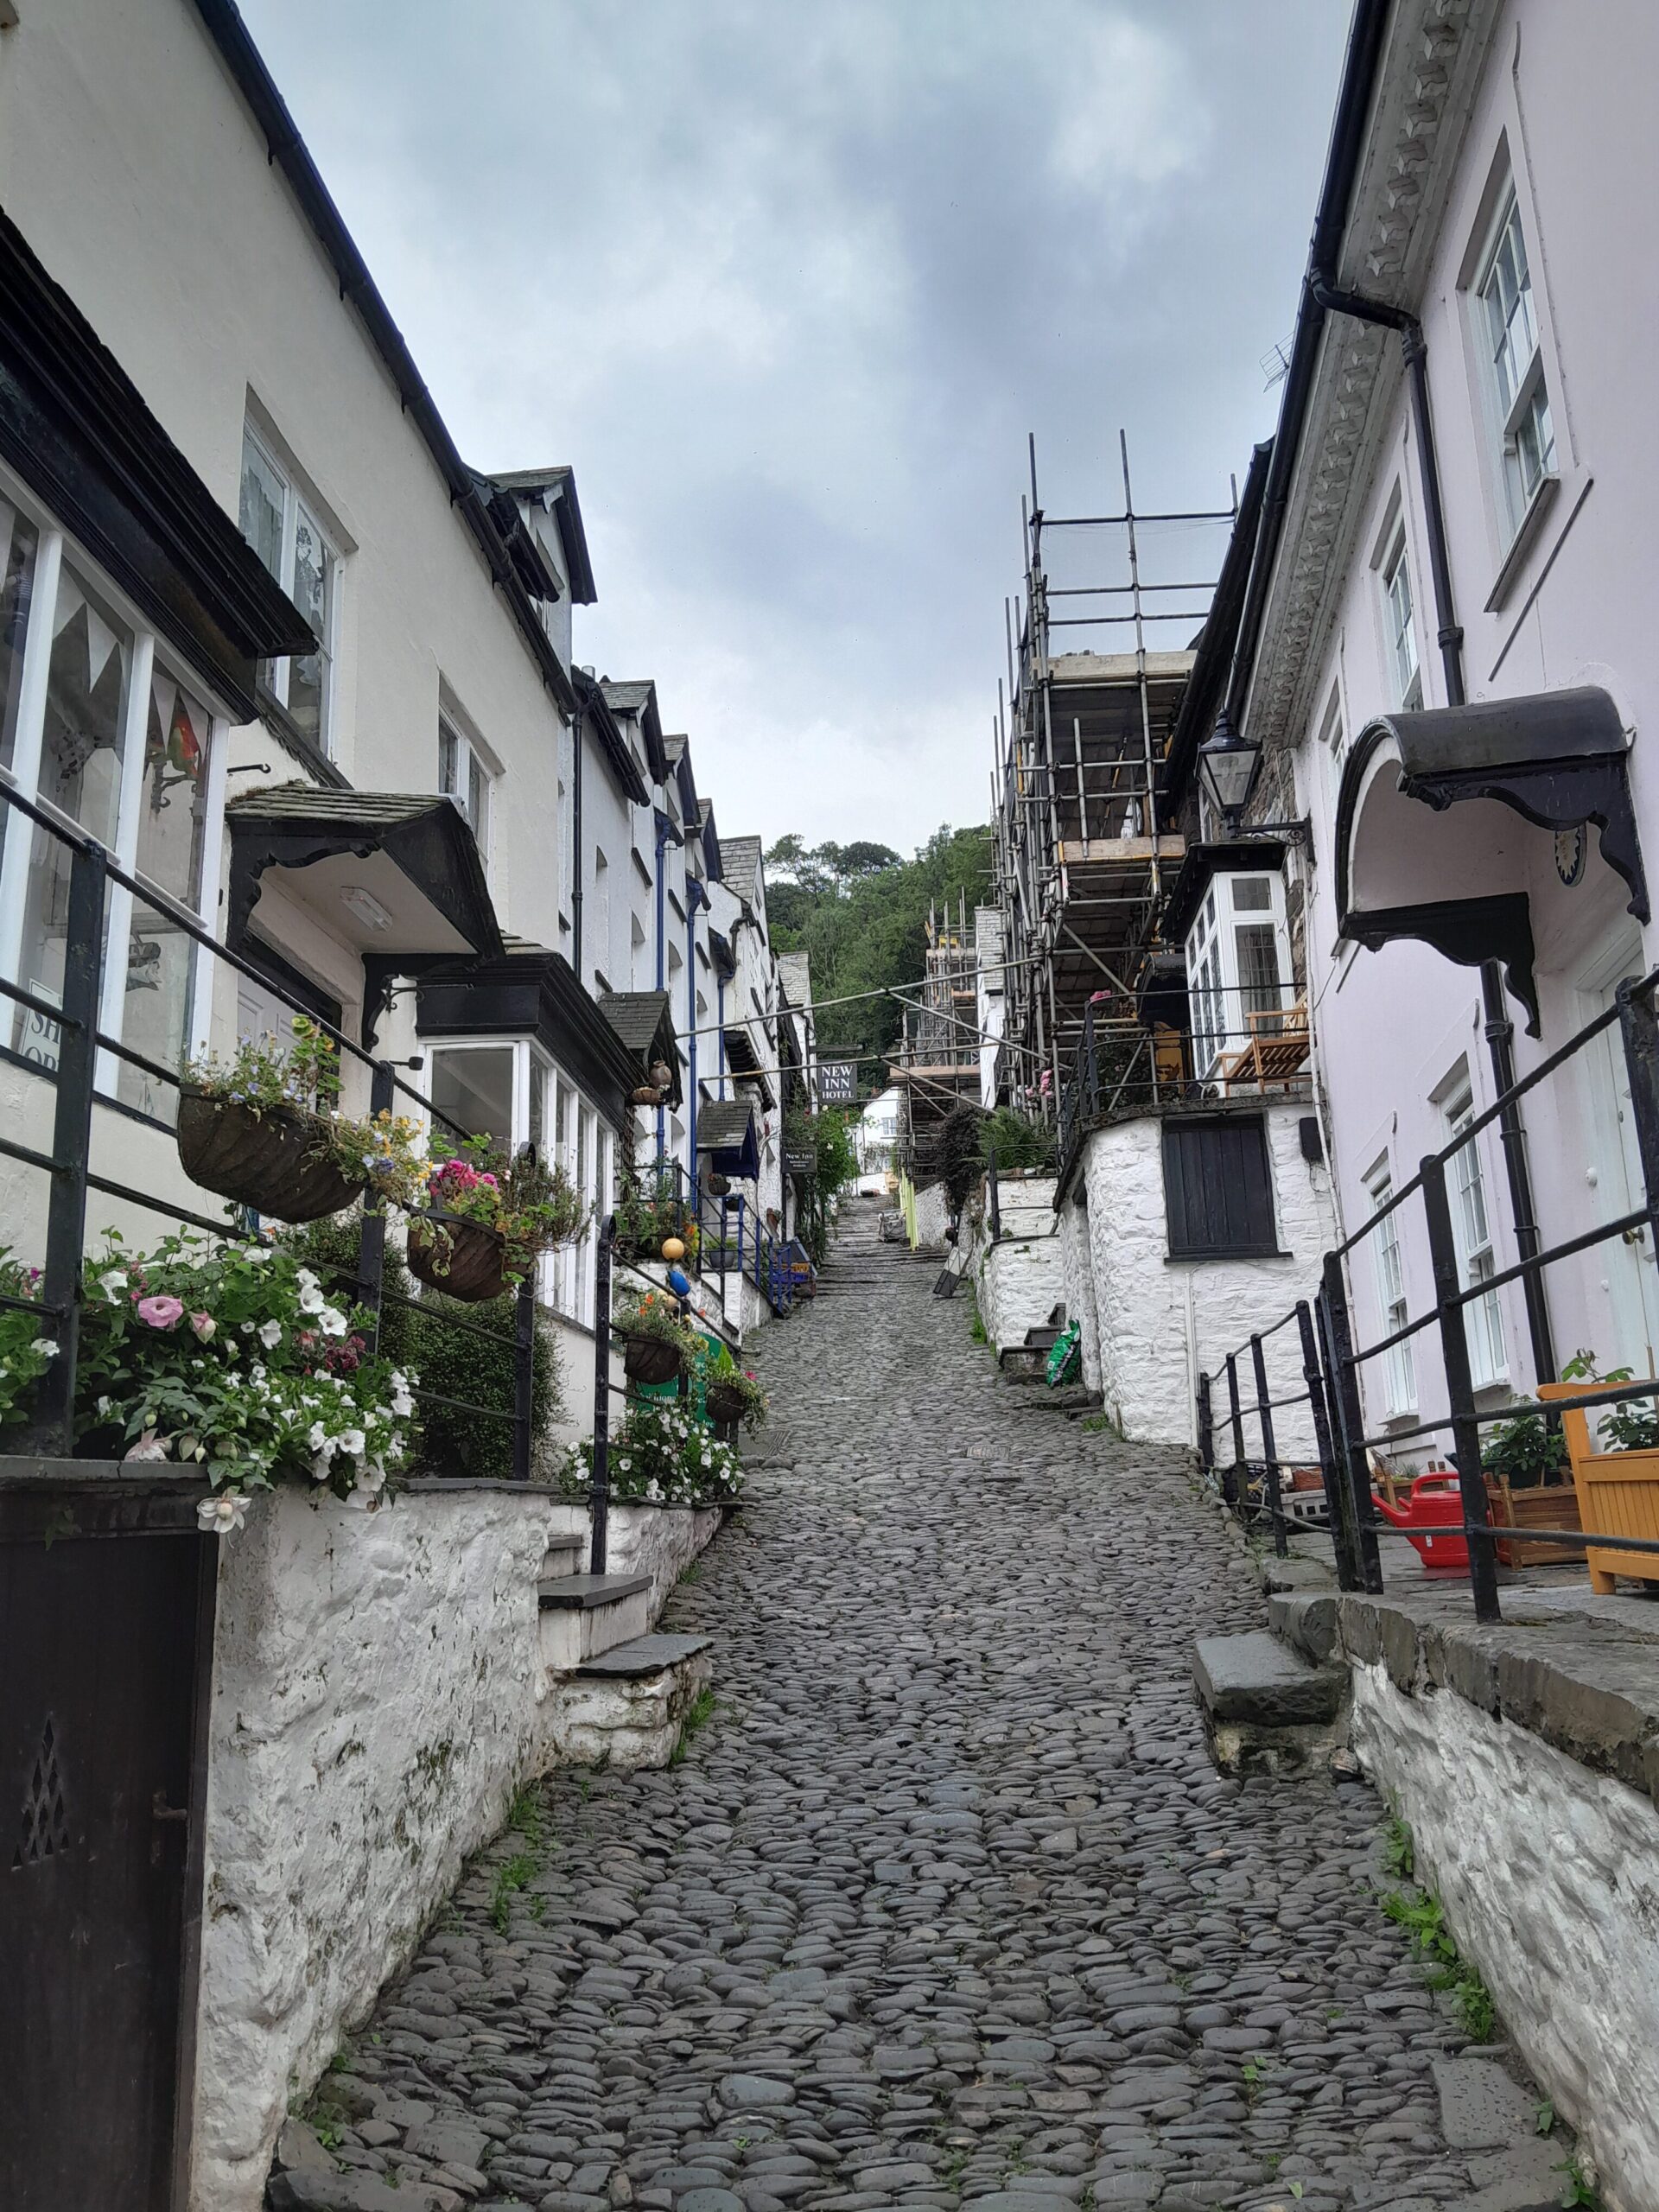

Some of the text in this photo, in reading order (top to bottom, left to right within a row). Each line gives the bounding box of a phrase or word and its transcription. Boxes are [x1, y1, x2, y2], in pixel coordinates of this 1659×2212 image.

[822, 1065, 853, 1077] NEW
[825, 1078, 850, 1089] INN
[822, 1090, 854, 1099] HOTEL
